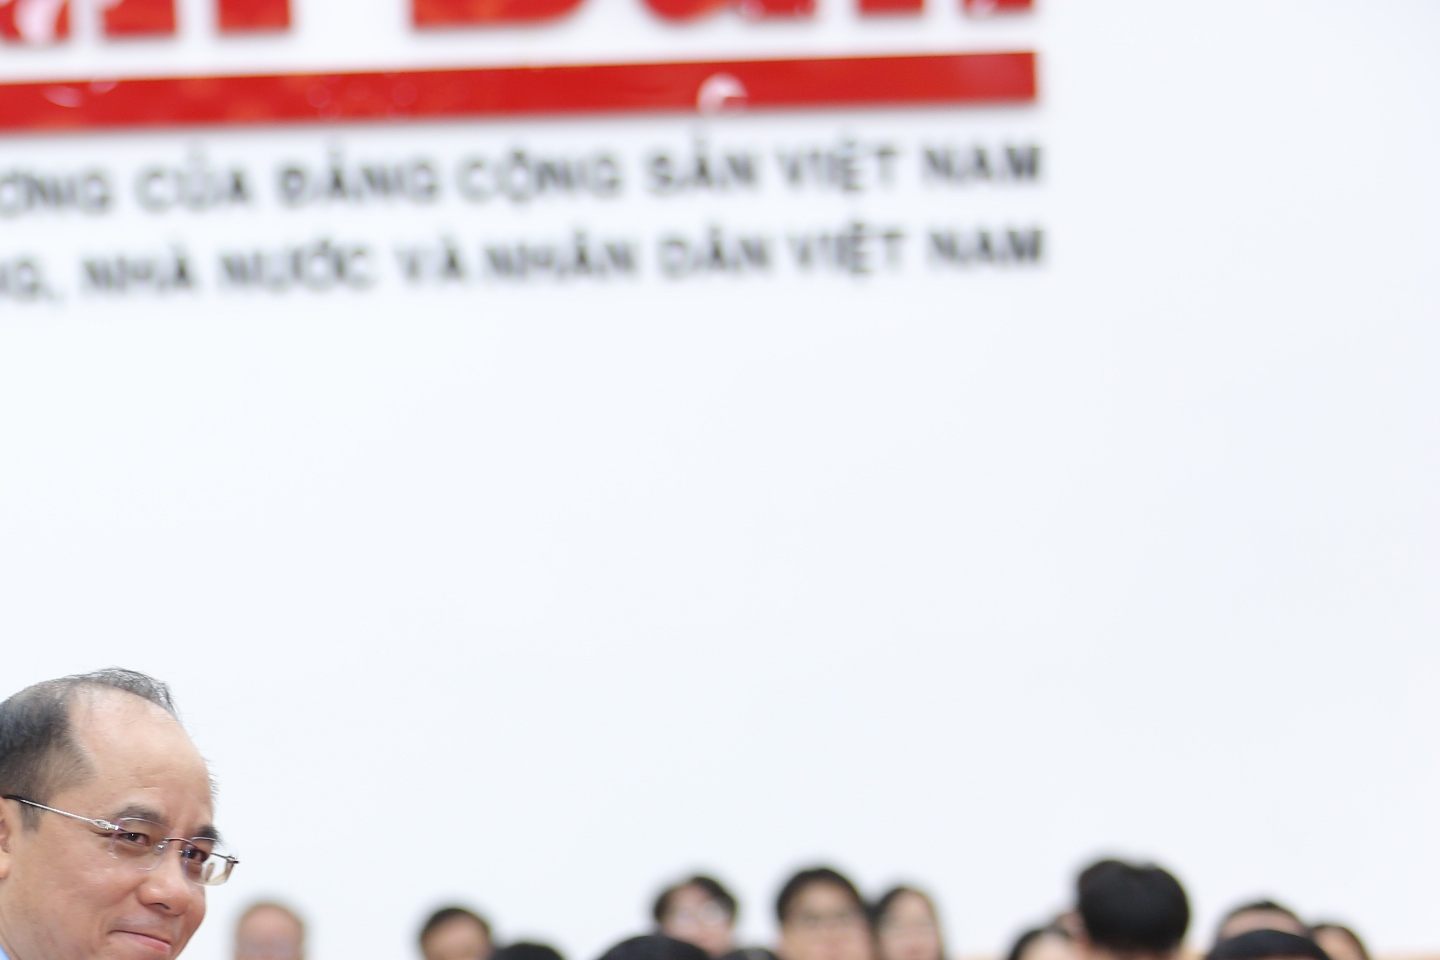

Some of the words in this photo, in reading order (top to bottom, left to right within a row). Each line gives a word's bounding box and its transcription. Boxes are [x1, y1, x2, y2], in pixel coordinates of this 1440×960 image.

[776, 138, 901, 196] VIỆT
[920, 141, 1045, 188] NAM
[79, 244, 201, 297] NHÀ
[394, 235, 472, 287] VÀ
[786, 218, 907, 280] VIỆT
[925, 224, 1048, 271] NAM
